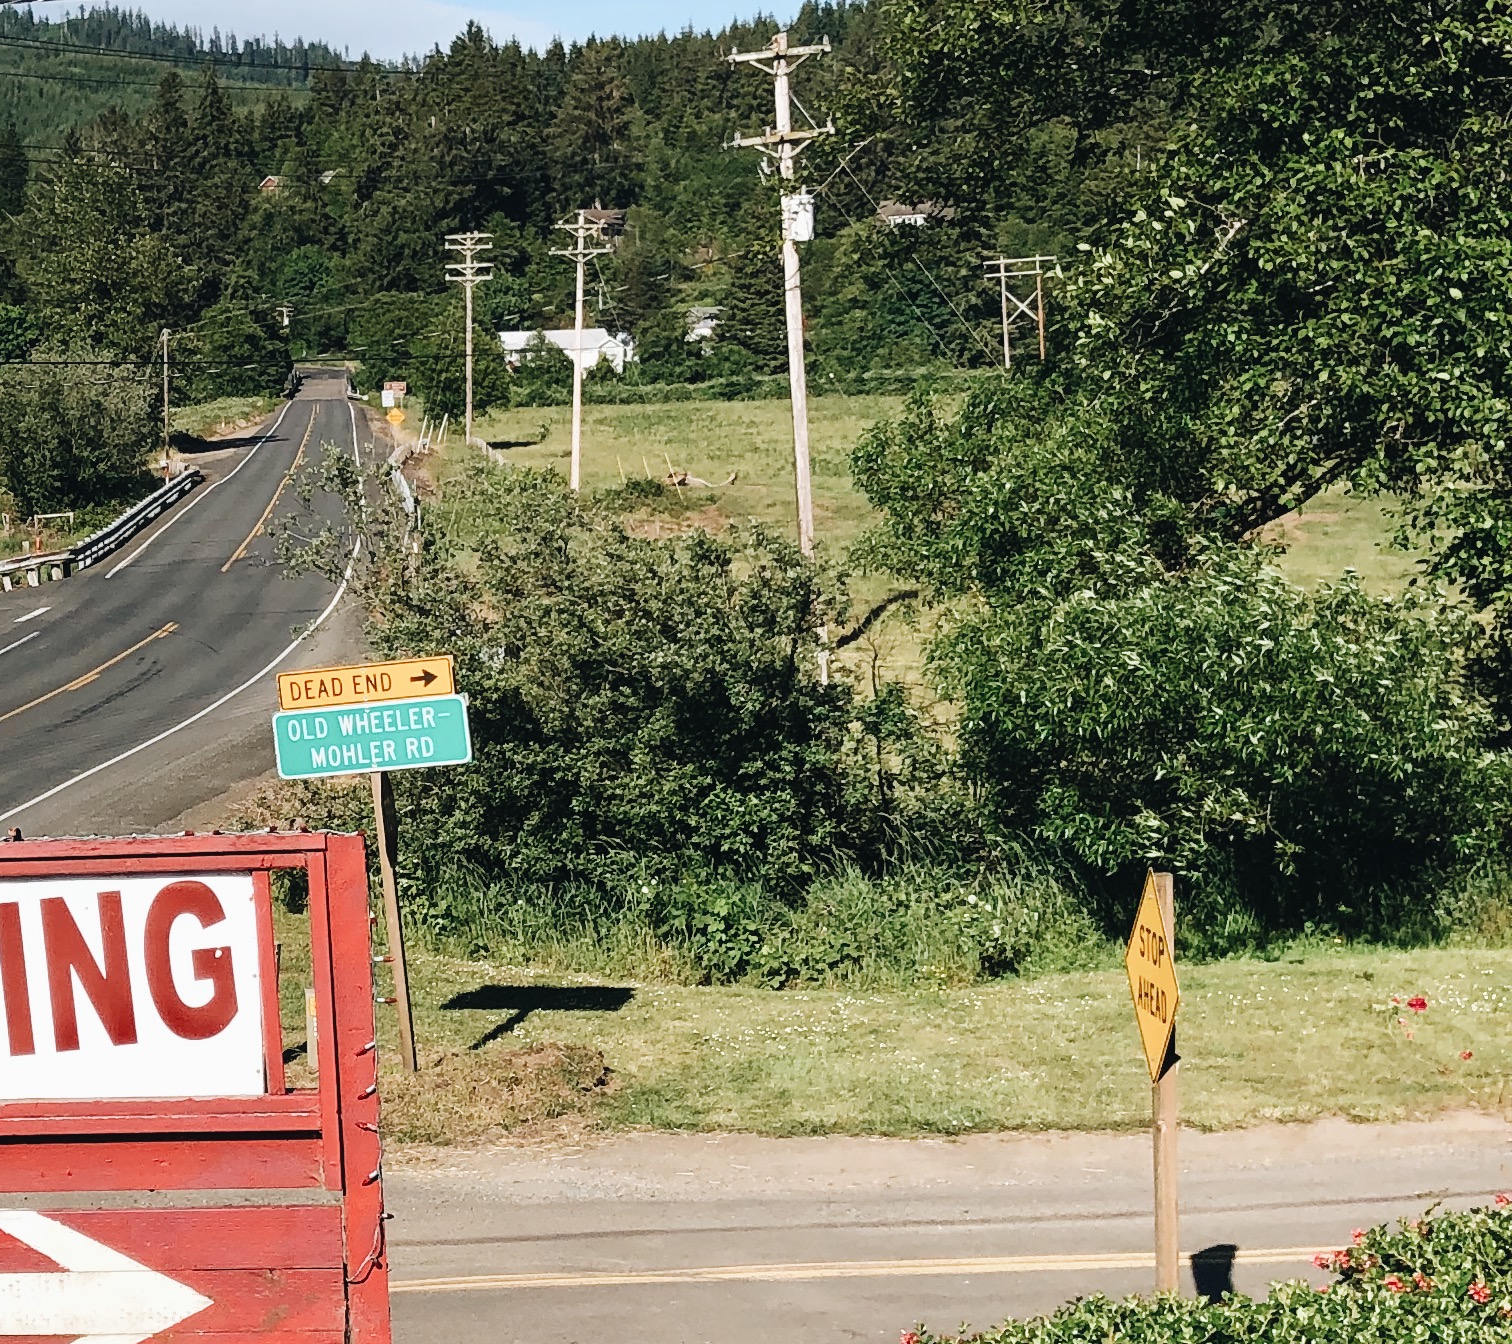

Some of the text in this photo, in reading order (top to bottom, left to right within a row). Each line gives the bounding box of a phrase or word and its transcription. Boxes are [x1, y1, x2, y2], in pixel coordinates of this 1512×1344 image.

[290, 672, 392, 701] DEAD END
[288, 717, 328, 742] OLD
[310, 736, 434, 769] MOHLER RD
[1139, 924, 1165, 968] STOP
[1138, 975, 1167, 1024] AHEAD
